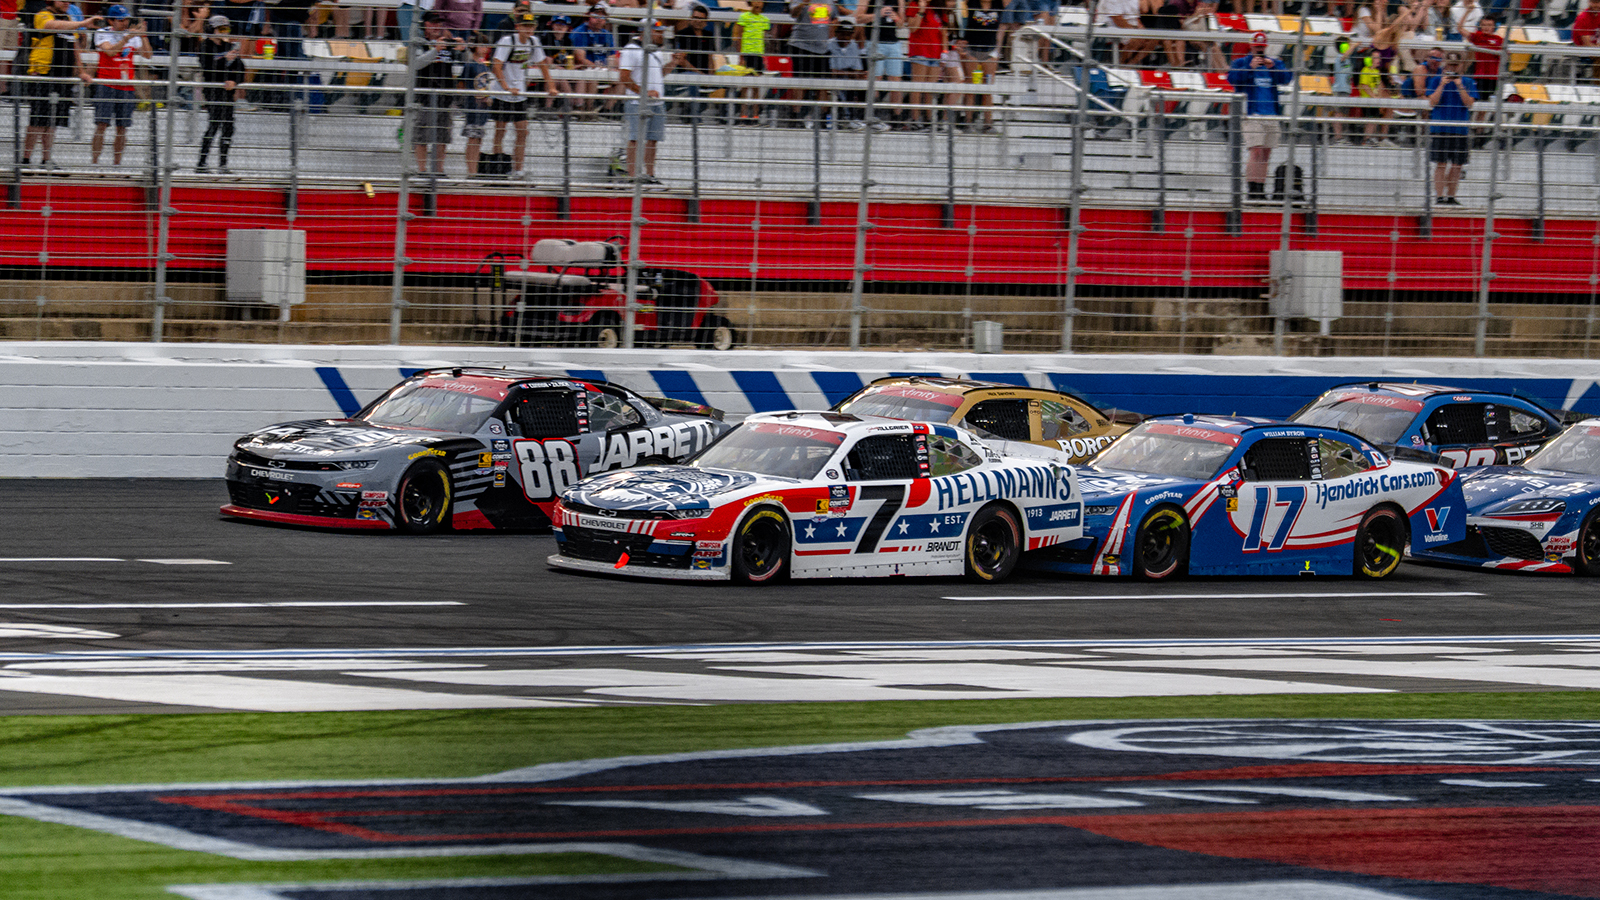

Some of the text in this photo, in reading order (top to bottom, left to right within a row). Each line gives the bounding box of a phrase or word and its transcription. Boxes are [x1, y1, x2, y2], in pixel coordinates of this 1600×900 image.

[442, 382, 482, 394] xfinity
[900, 389, 940, 401] xfinity
[1362, 395, 1399, 407] xfinity
[776, 427, 818, 438] xfinity
[1174, 428, 1215, 439] xfinity
[589, 420, 713, 474] JARRETT
[251, 469, 294, 480] CHEVROLET
[514, 439, 581, 499] 88
[1145, 491, 1183, 505] GOODYEAR
[1027, 508, 1043, 518] 1913
[1049, 509, 1078, 521] JARRETT
[1242, 484, 1307, 553] 17
[581, 518, 626, 530] CHEVROLET
[855, 485, 906, 554] 7
[944, 515, 964, 525] EST.
[1424, 533, 1449, 543] Valvoline
[925, 541, 962, 552] BRANDT
